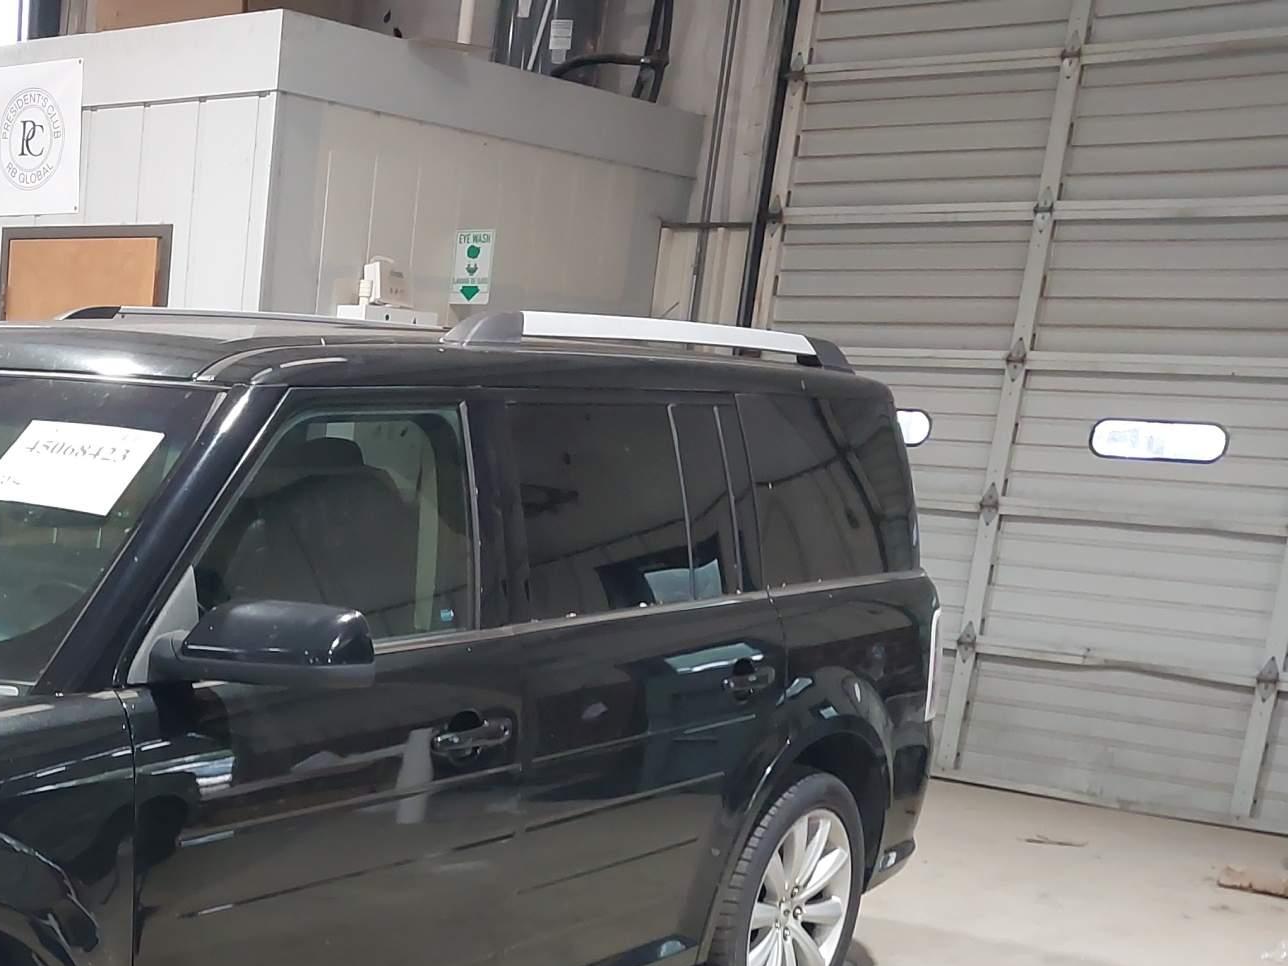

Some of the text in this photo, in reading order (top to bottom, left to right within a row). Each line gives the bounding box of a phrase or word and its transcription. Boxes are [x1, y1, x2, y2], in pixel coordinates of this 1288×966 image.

[1, 93, 62, 140] PRESIDENT'S CLUB
[6, 161, 54, 185] RB GLOBAL
[458, 232, 491, 244] EYE WASH
